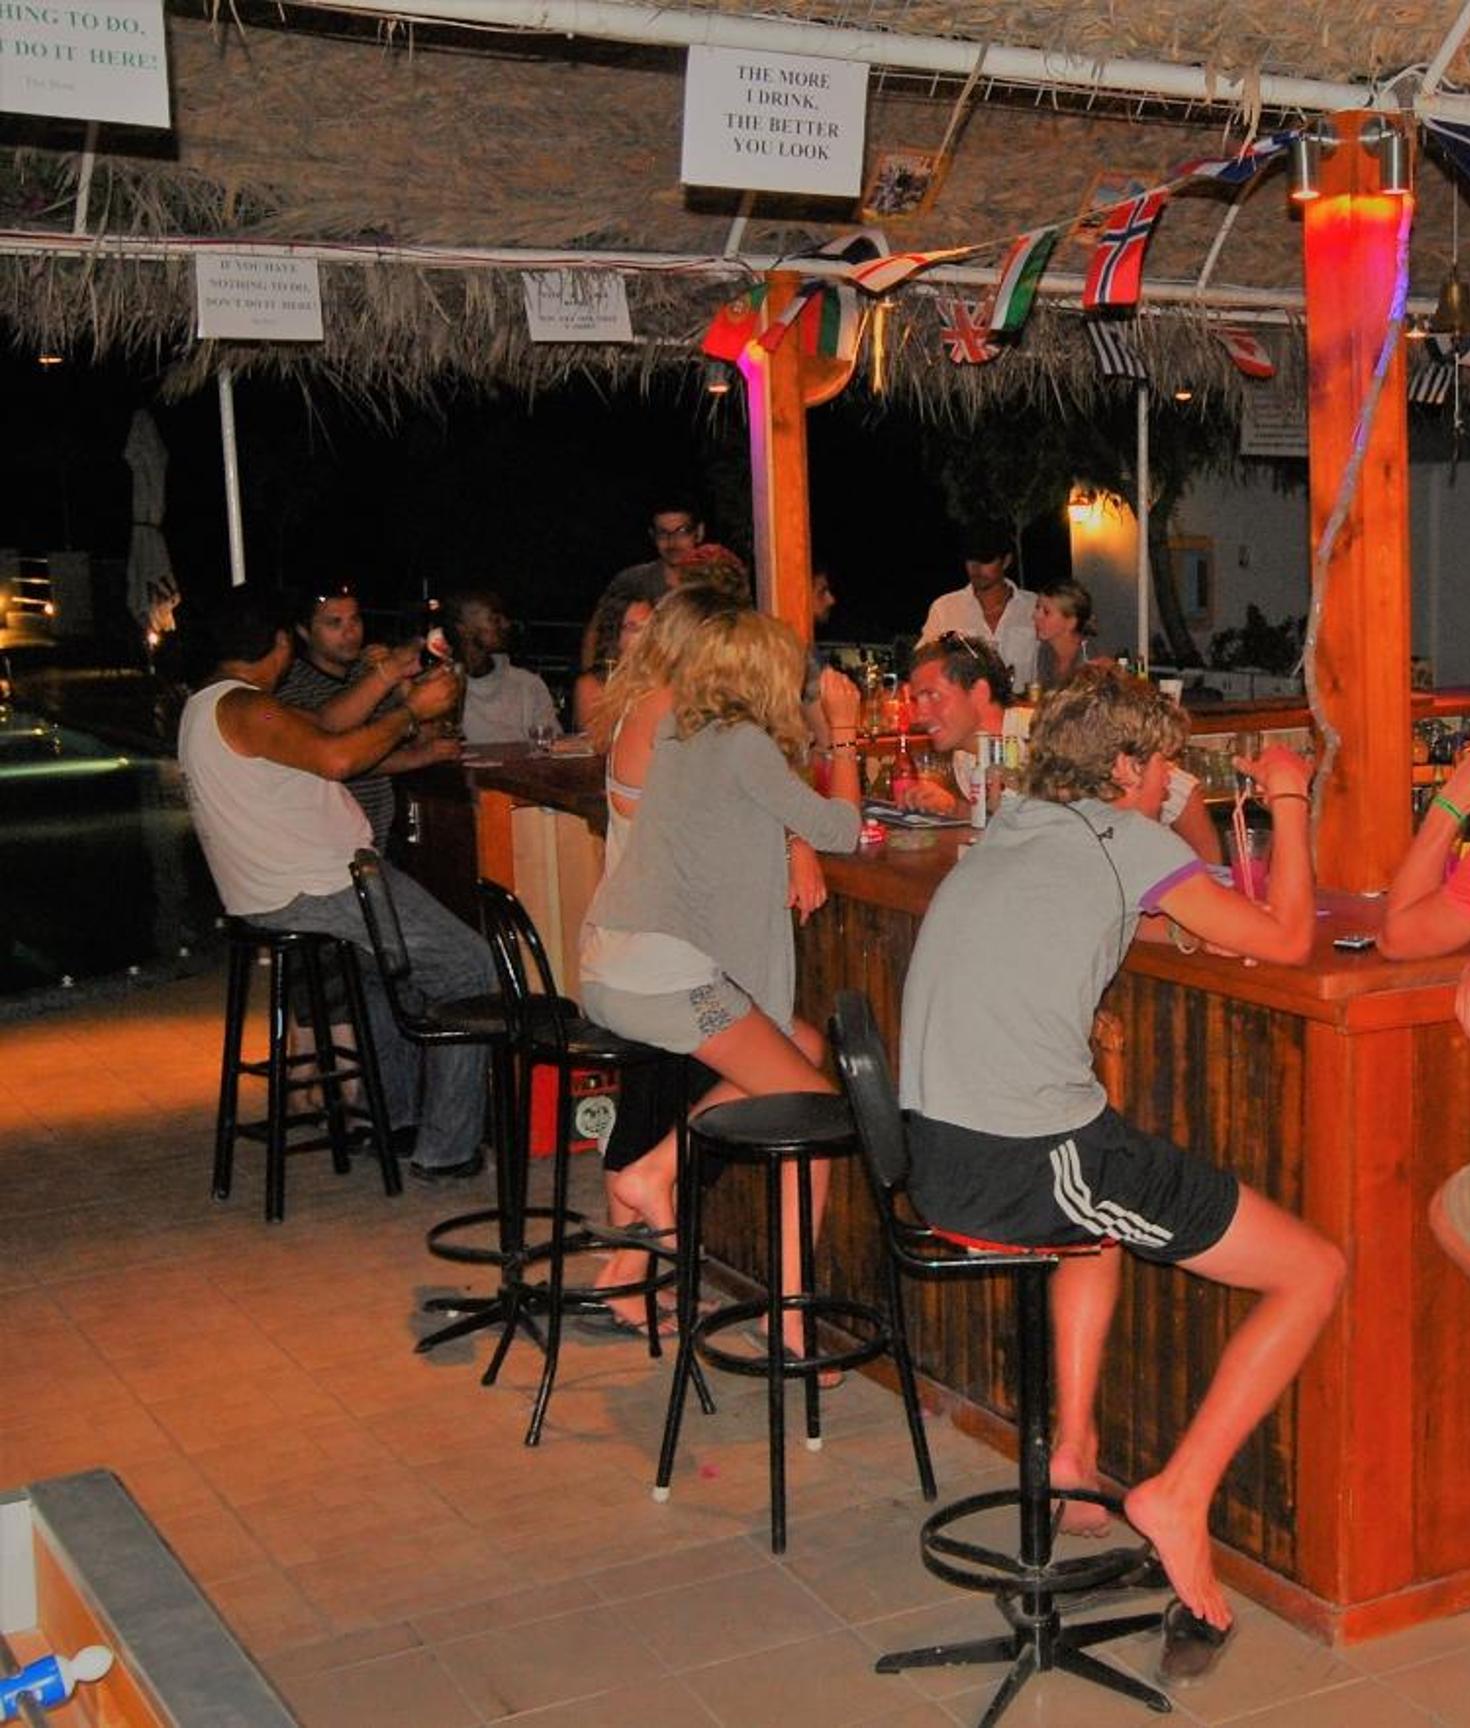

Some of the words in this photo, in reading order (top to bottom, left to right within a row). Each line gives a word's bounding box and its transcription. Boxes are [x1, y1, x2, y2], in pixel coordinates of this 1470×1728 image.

[64, 11, 99, 30] TO
[15, 40, 48, 57] DO
[55, 44, 77, 61] IT
[90, 48, 158, 70] HERE!
[737, 65, 773, 83] THE
[779, 69, 830, 89] MORE
[746, 88, 753, 104] I
[724, 113, 761, 131] THE
[769, 116, 840, 138] BETTER
[733, 137, 773, 155] YOU
[779, 141, 830, 161] LOOK
